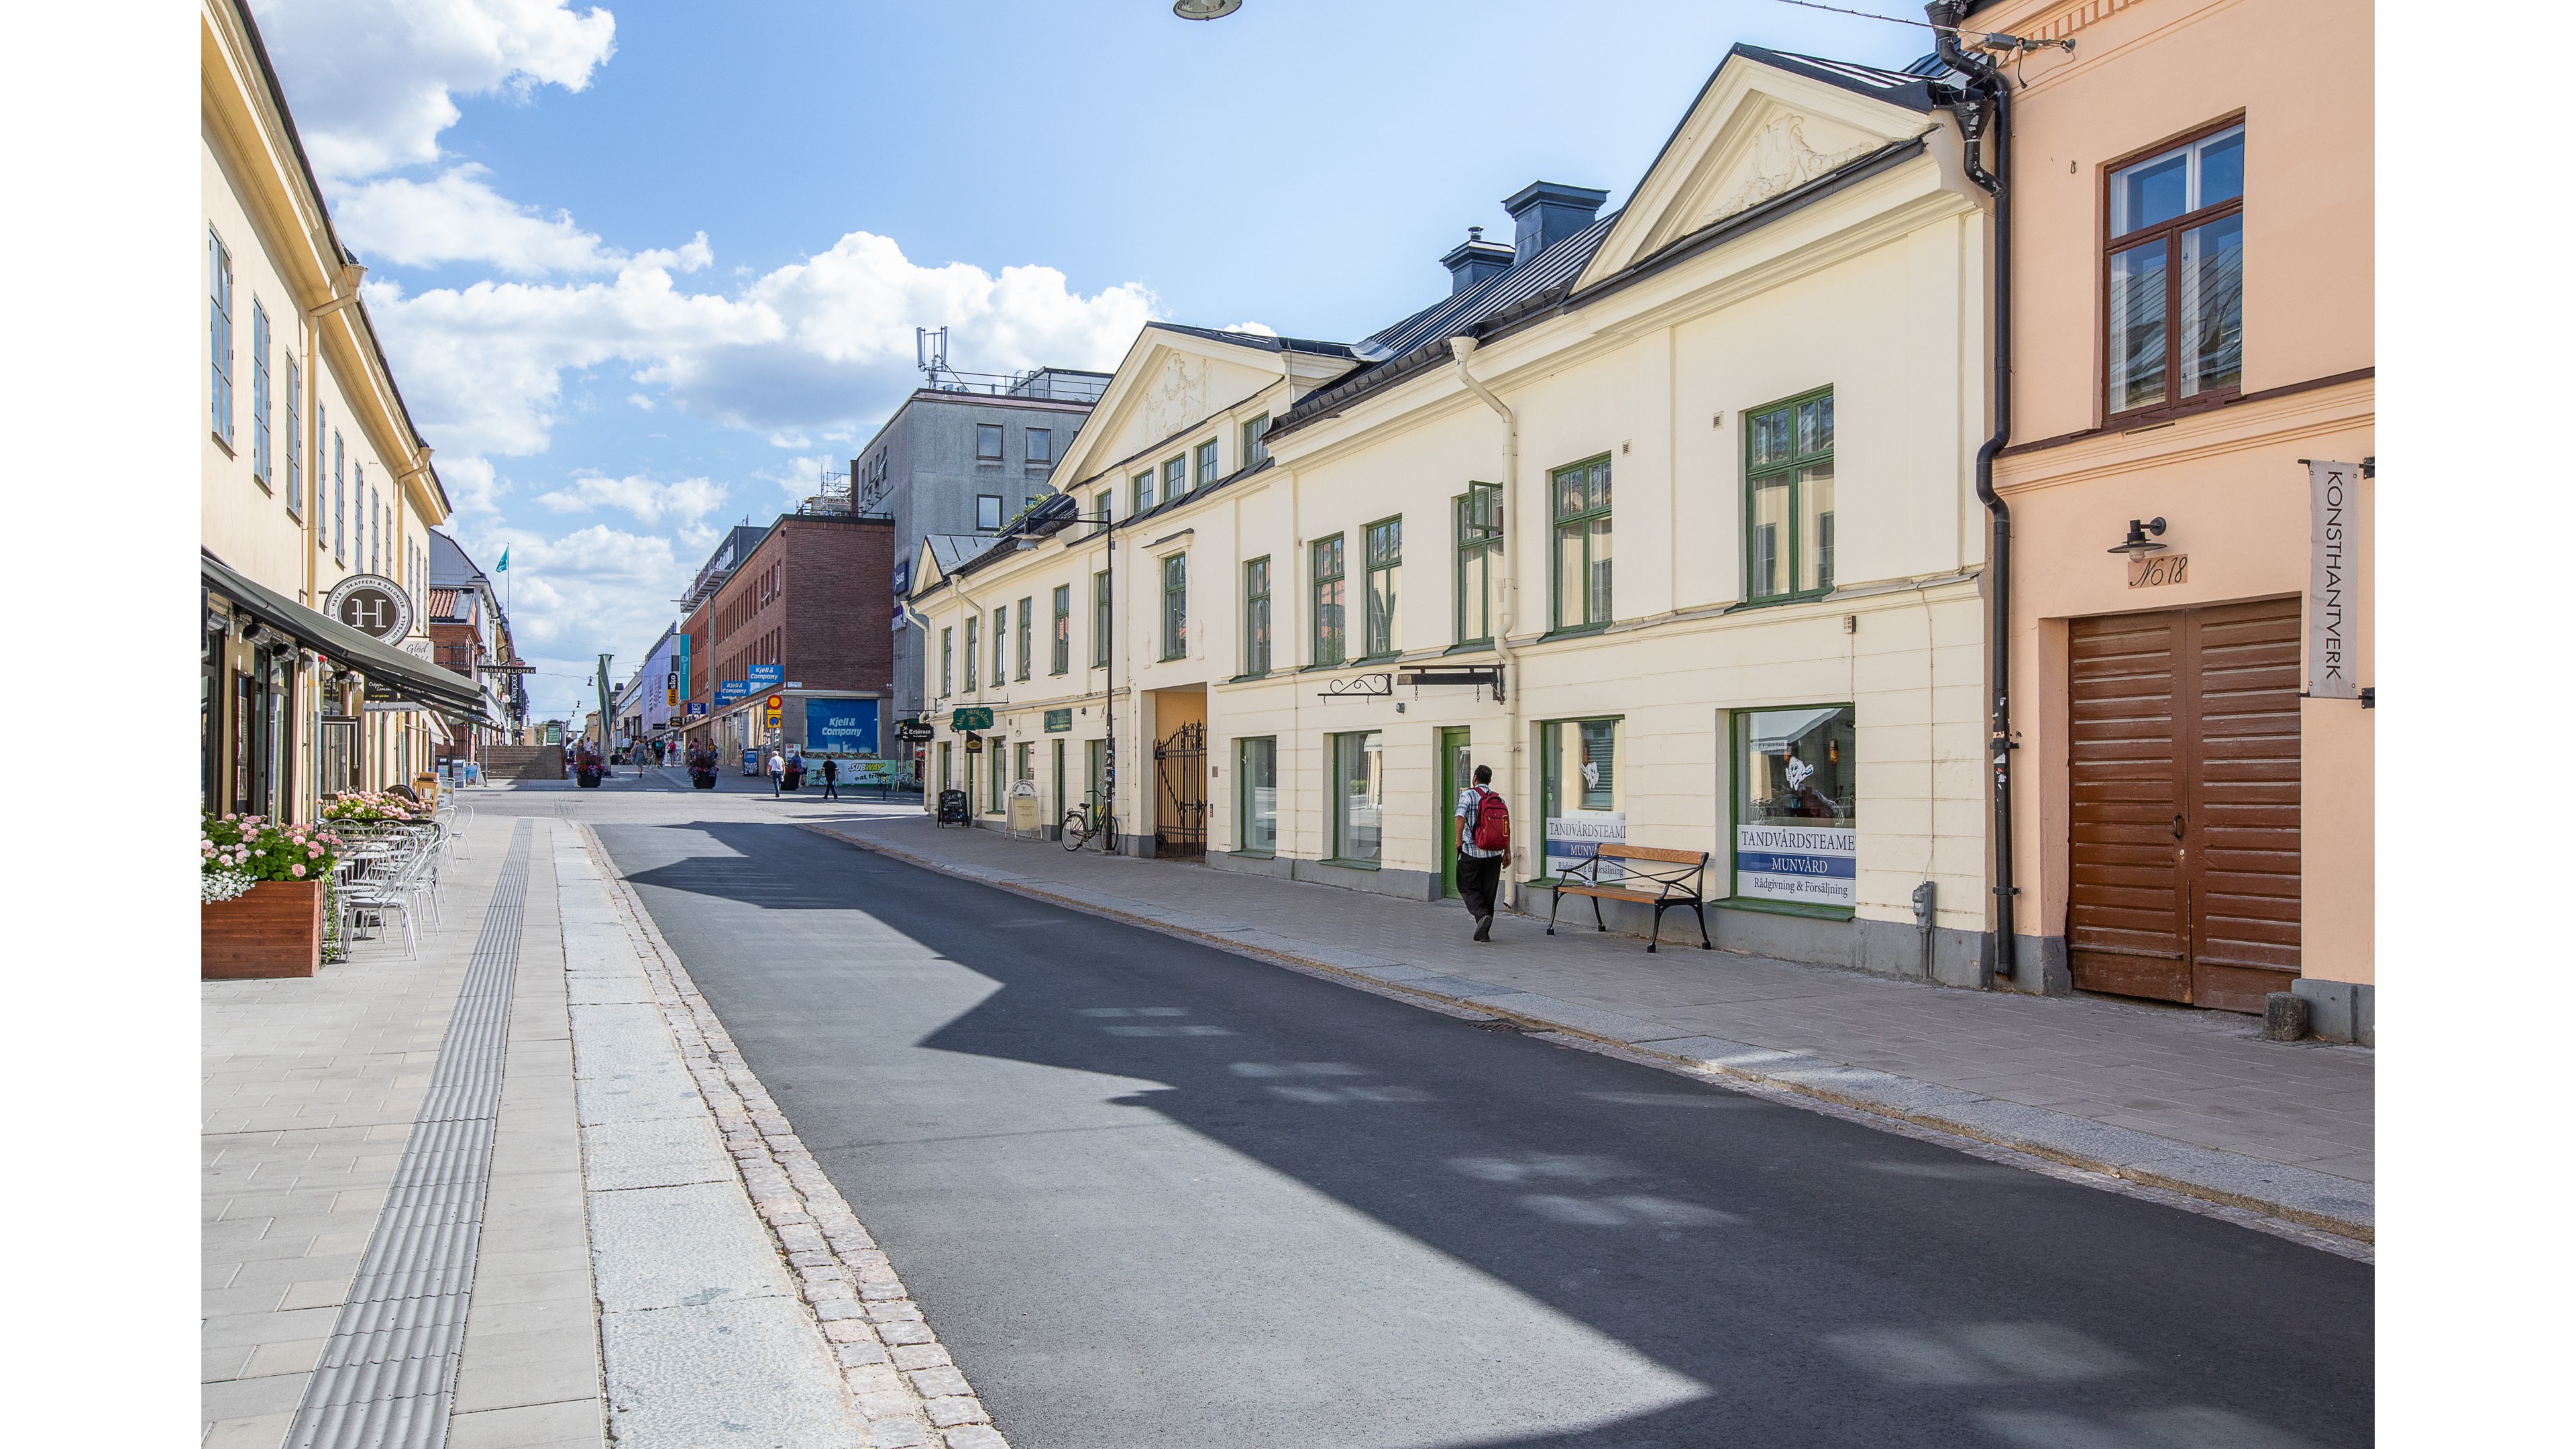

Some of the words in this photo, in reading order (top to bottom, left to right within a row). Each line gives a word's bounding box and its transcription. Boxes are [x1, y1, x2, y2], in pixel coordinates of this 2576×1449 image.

[2129, 558, 2164, 588] No
[2168, 556, 2188, 585] 18
[2326, 471, 2343, 680] KONSTHANTVERK
[332, 592, 342, 607] HAVA
[346, 580, 376, 590] SKAFFERI
[383, 584, 405, 608] SALONGER
[352, 598, 386, 628] H
[392, 616, 407, 639] UPPSALA
[406, 643, 429, 654] Glöd
[829, 717, 849, 727] Kjell
[849, 718, 856, 727] &
[822, 727, 862, 737] Company
[849, 762, 885, 772] SUBWAY
[1741, 828, 1856, 851] TANDVÅRDSTEAME
[1587, 864, 1593, 873] &
[1597, 865, 1623, 877] örsäljning
[1772, 857, 1828, 873] MUNVÅRD
[1754, 877, 1795, 894] Rådgivning
[1796, 881, 1803, 892] &
[1805, 881, 1848, 898] Försäljning
